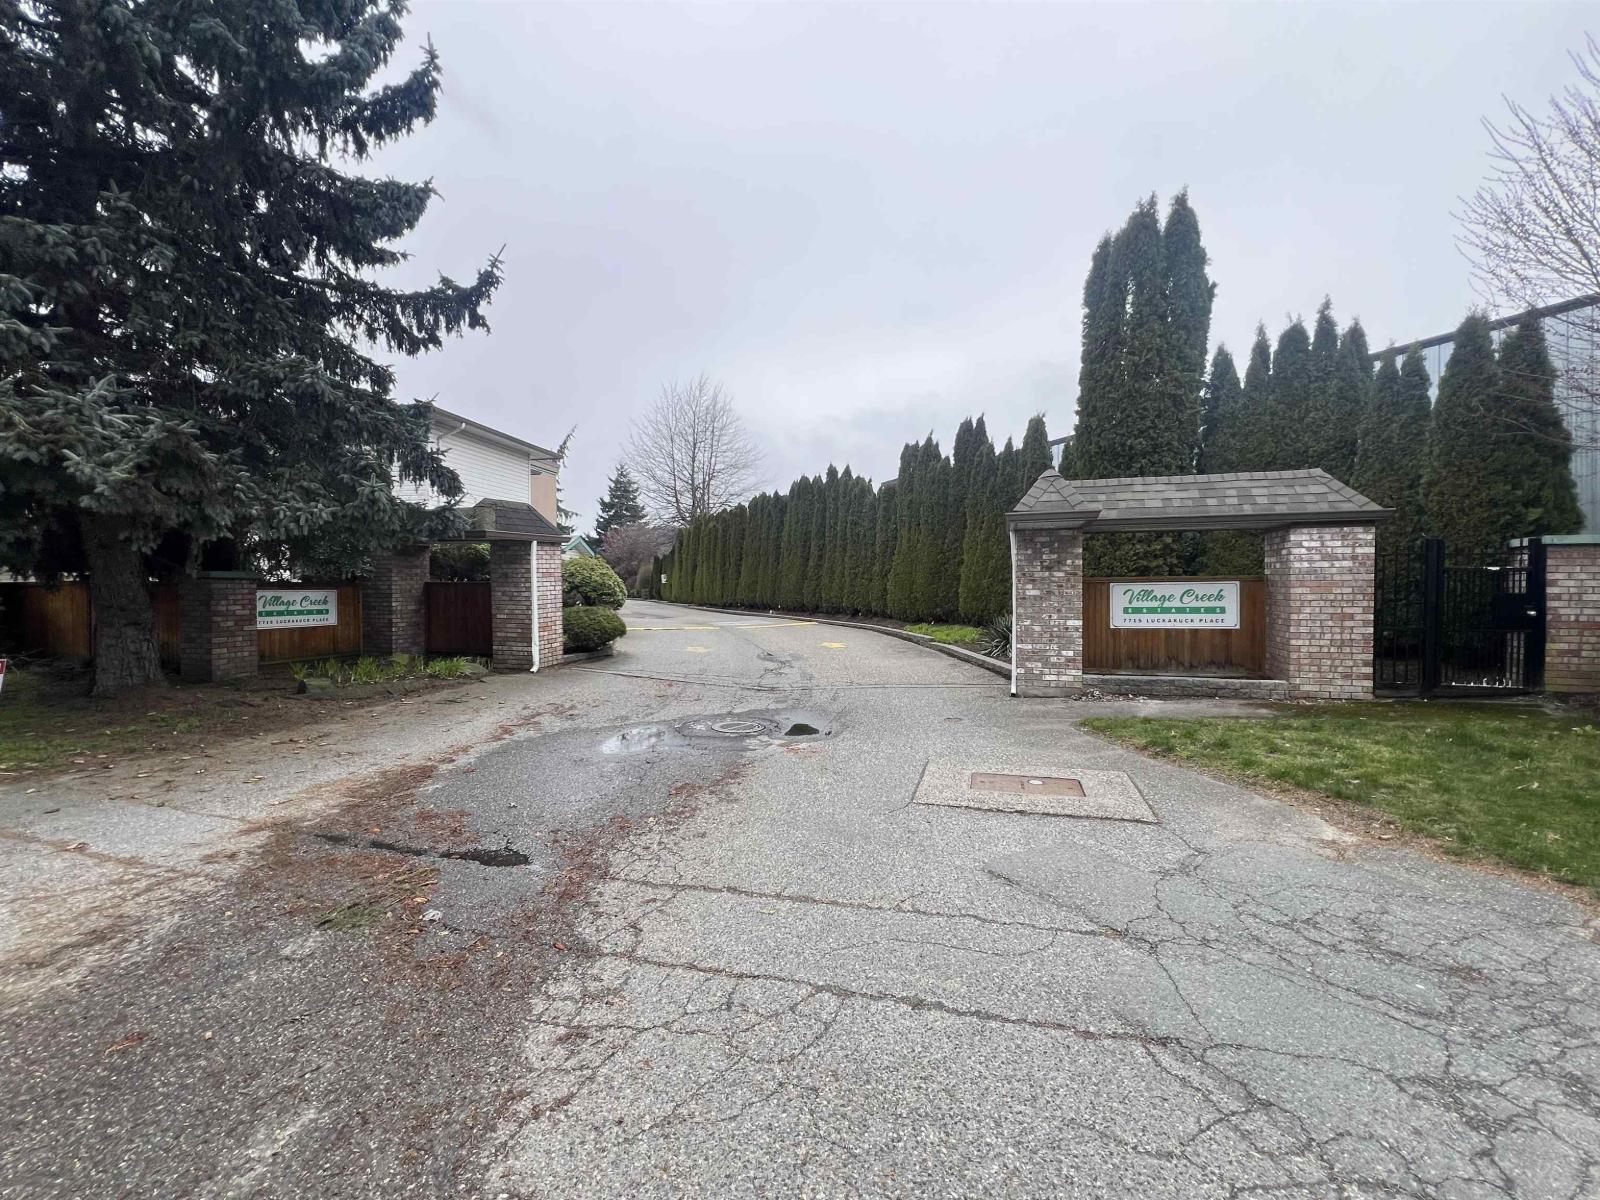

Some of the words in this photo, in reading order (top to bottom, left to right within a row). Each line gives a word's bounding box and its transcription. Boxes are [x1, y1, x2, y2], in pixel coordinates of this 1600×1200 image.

[258, 595, 298, 610] Village
[299, 595, 329, 608] Creek
[1122, 588, 1176, 607] Village
[1179, 588, 1226, 605] Creek
